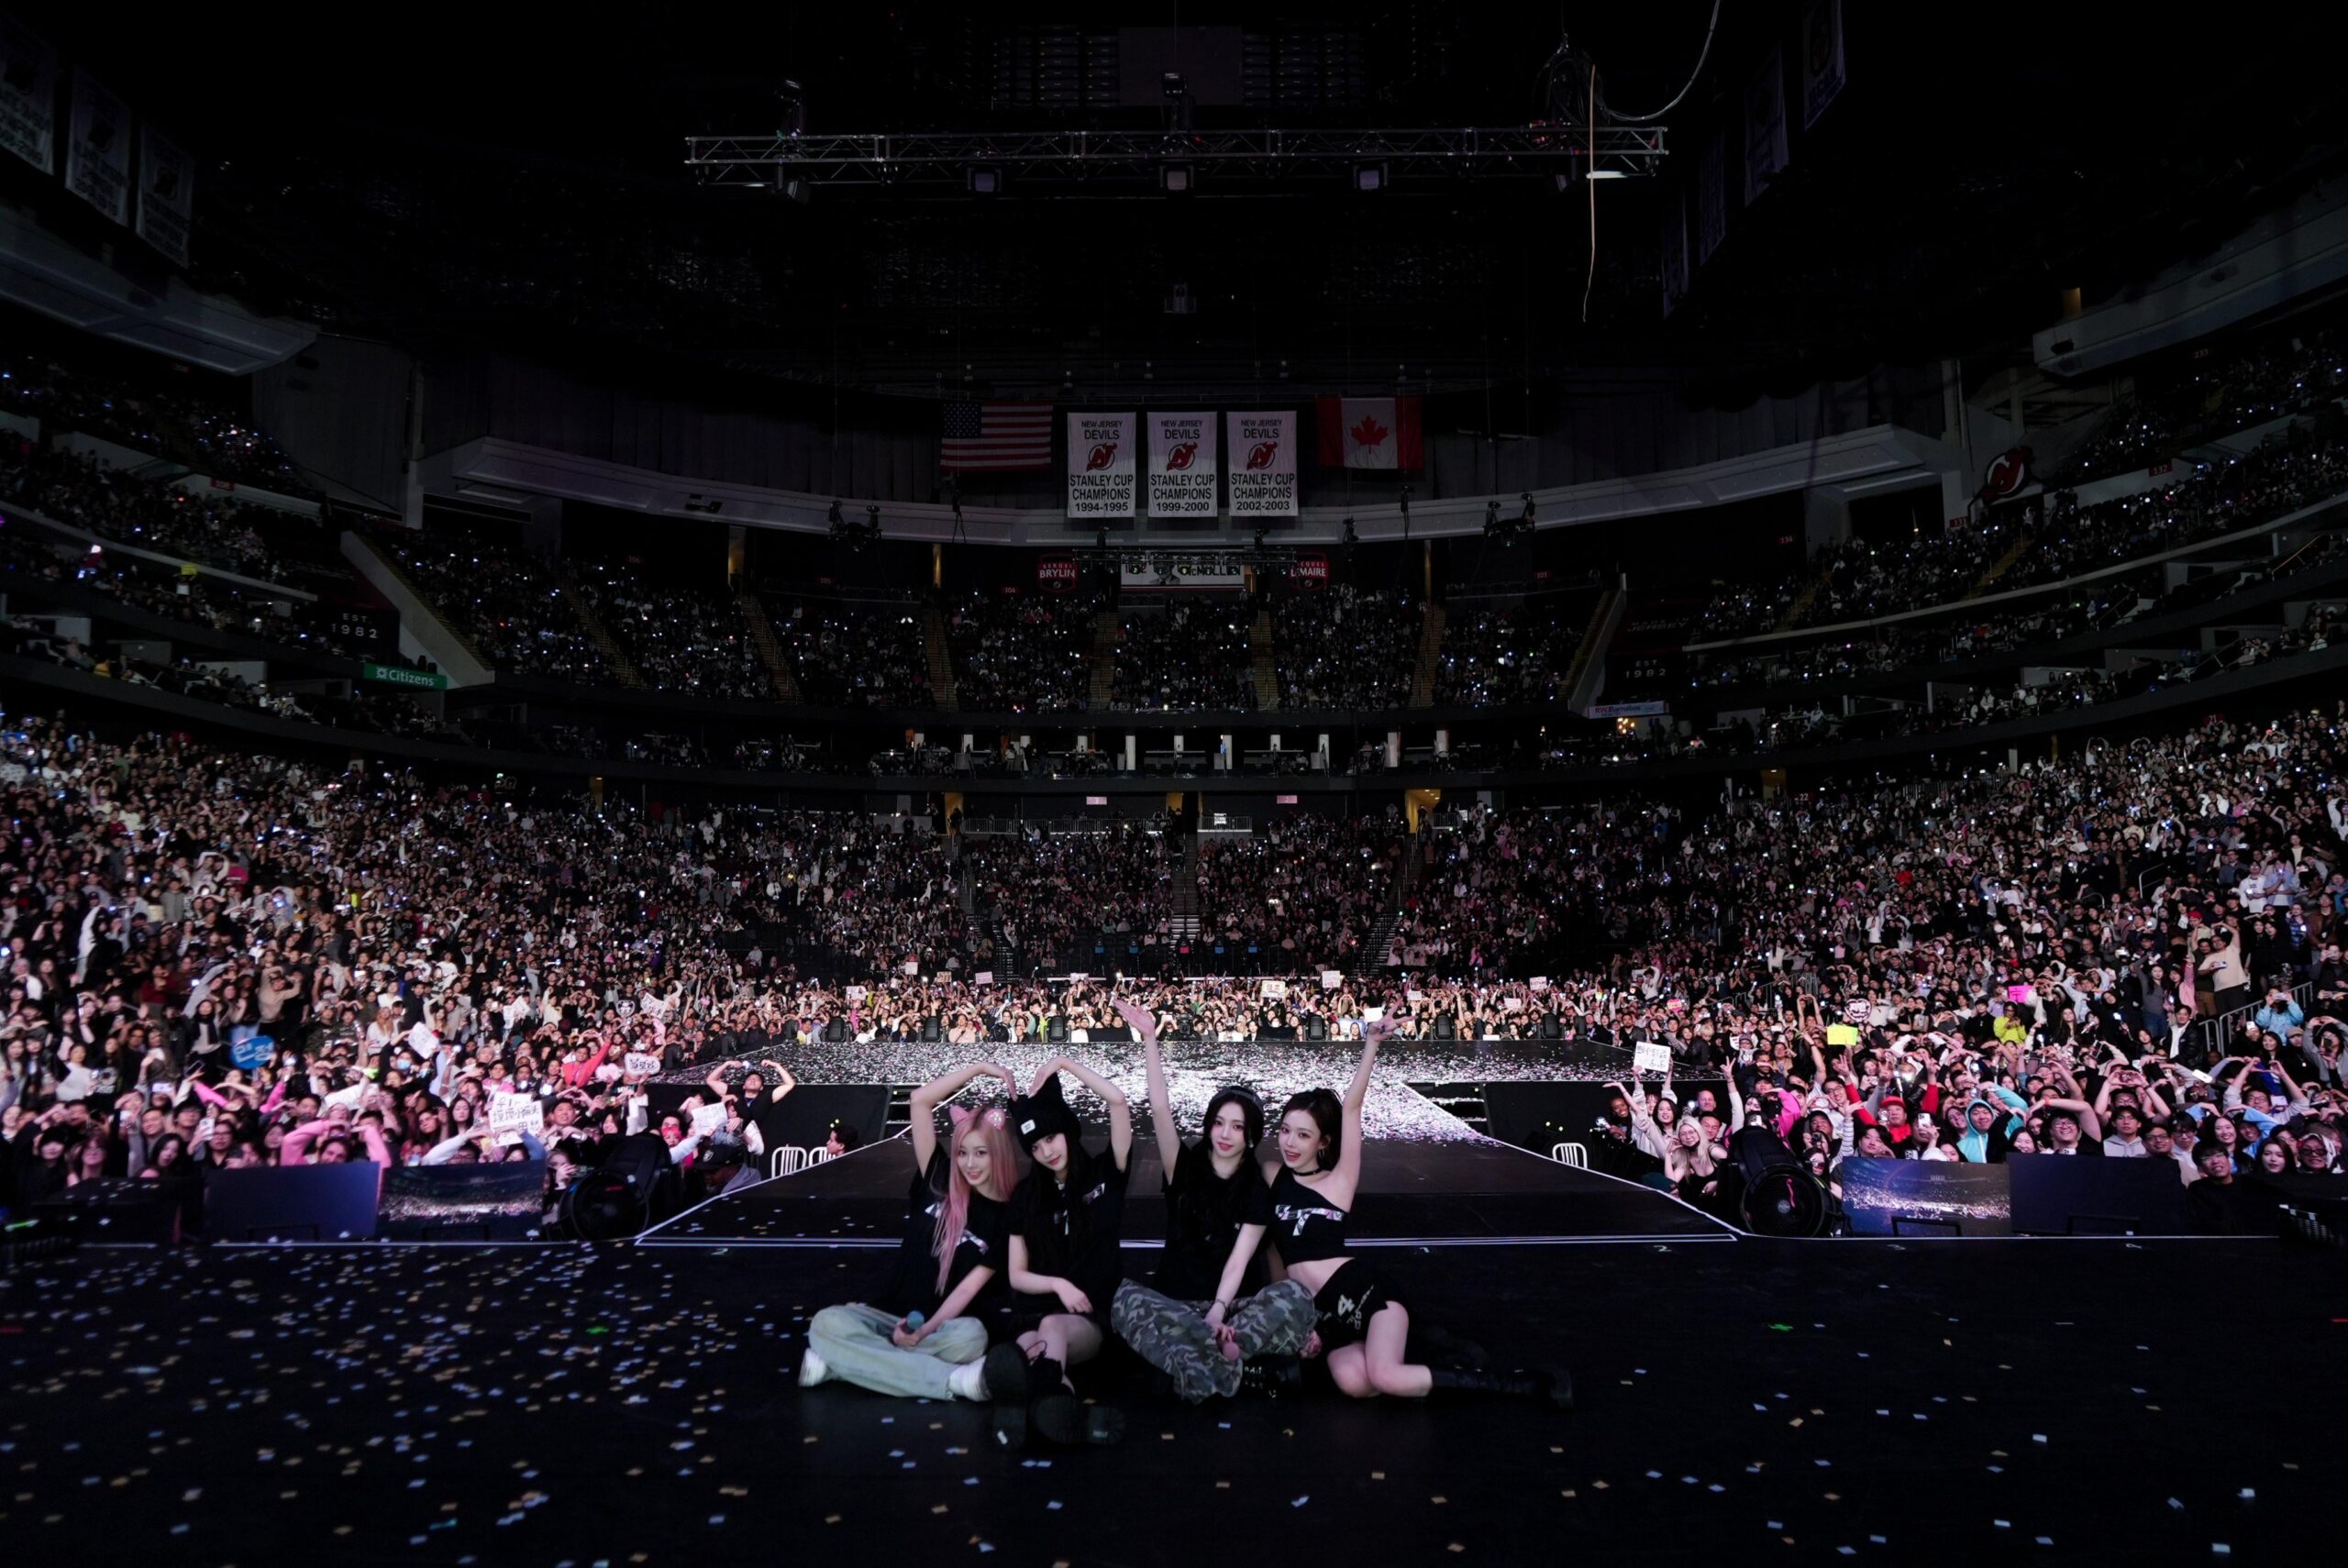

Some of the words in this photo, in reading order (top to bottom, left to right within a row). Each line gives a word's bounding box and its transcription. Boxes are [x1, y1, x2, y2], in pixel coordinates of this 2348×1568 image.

[1080, 420, 1099, 428] NEW
[1100, 420, 1123, 428] JERSEY
[1241, 419, 1257, 427] NEW
[1257, 419, 1282, 427] JERSEY
[1084, 429, 1120, 440] DEVILS
[1164, 429, 1201, 439] DEVILS
[1244, 428, 1279, 438] DEVILS
[1069, 474, 1112, 486] STANLEY
[1113, 474, 1133, 486] CUP
[1150, 474, 1194, 486] STANLEY
[1195, 474, 1215, 486] CUP
[1231, 473, 1272, 485] STANLEY
[1275, 473, 1295, 484] CUP
[1072, 488, 1130, 500] CHAMPIONS
[1153, 488, 1212, 500] CHAMPIONS
[1234, 488, 1291, 499] CHAMPIONS
[1075, 502, 1128, 512] 1994-1995
[1156, 502, 1210, 512] 1999-2000
[1236, 501, 1290, 511] 2002-2003
[1039, 569, 1076, 579] BRYLIN
[330, 624, 378, 639] 1982
[388, 668, 435, 687] Citizens
[1625, 668, 1667, 679] 1982
